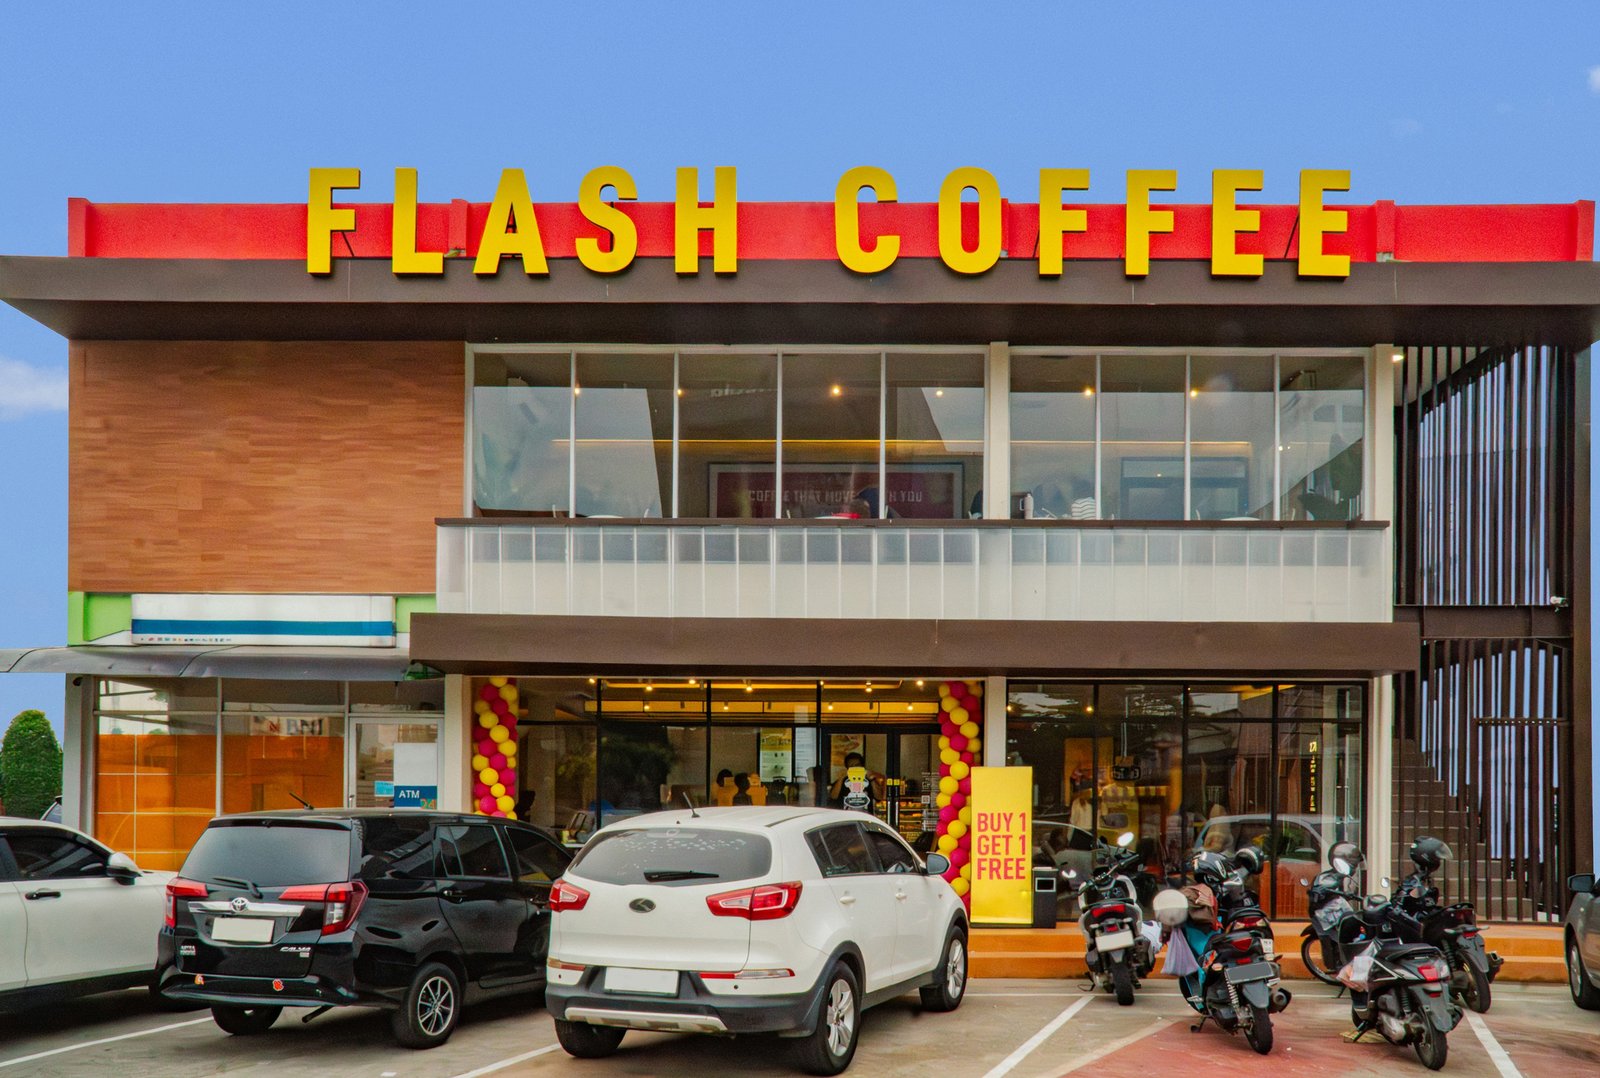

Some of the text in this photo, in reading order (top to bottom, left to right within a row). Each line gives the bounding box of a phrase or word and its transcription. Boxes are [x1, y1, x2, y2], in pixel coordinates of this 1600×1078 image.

[306, 165, 1352, 279] FLASH COFFEE
[750, 490, 790, 502] COFFE
[399, 790, 420, 798] ATM
[977, 812, 1026, 832] BUY 1
[977, 834, 1026, 855] GET 1
[977, 857, 1026, 880] FREE
